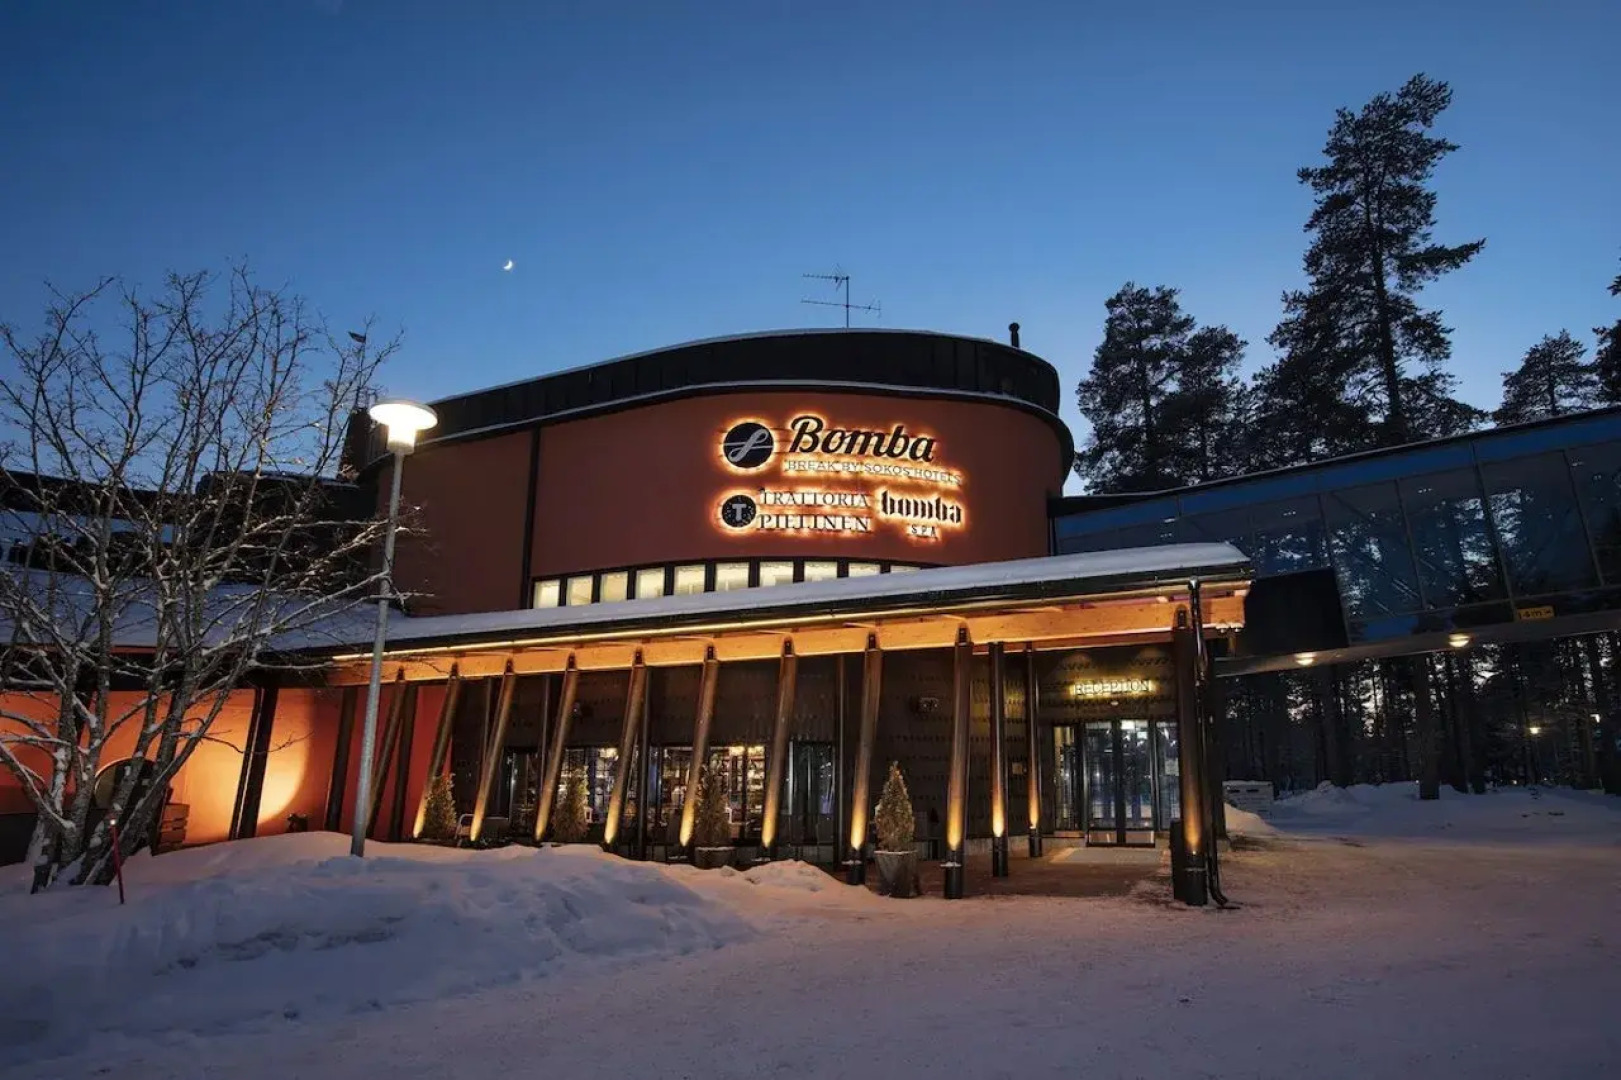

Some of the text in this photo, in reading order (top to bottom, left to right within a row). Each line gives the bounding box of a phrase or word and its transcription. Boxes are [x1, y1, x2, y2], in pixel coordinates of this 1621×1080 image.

[789, 415, 936, 462] Bomba
[788, 460, 962, 484] BREAK BY SOKOS HOTELS
[759, 489, 870, 507] TRATTORIA
[881, 490, 961, 523] bomba
[758, 514, 870, 532] PIELINEN
[911, 524, 937, 537] SPA
[1074, 680, 1151, 695] RECEPTION
